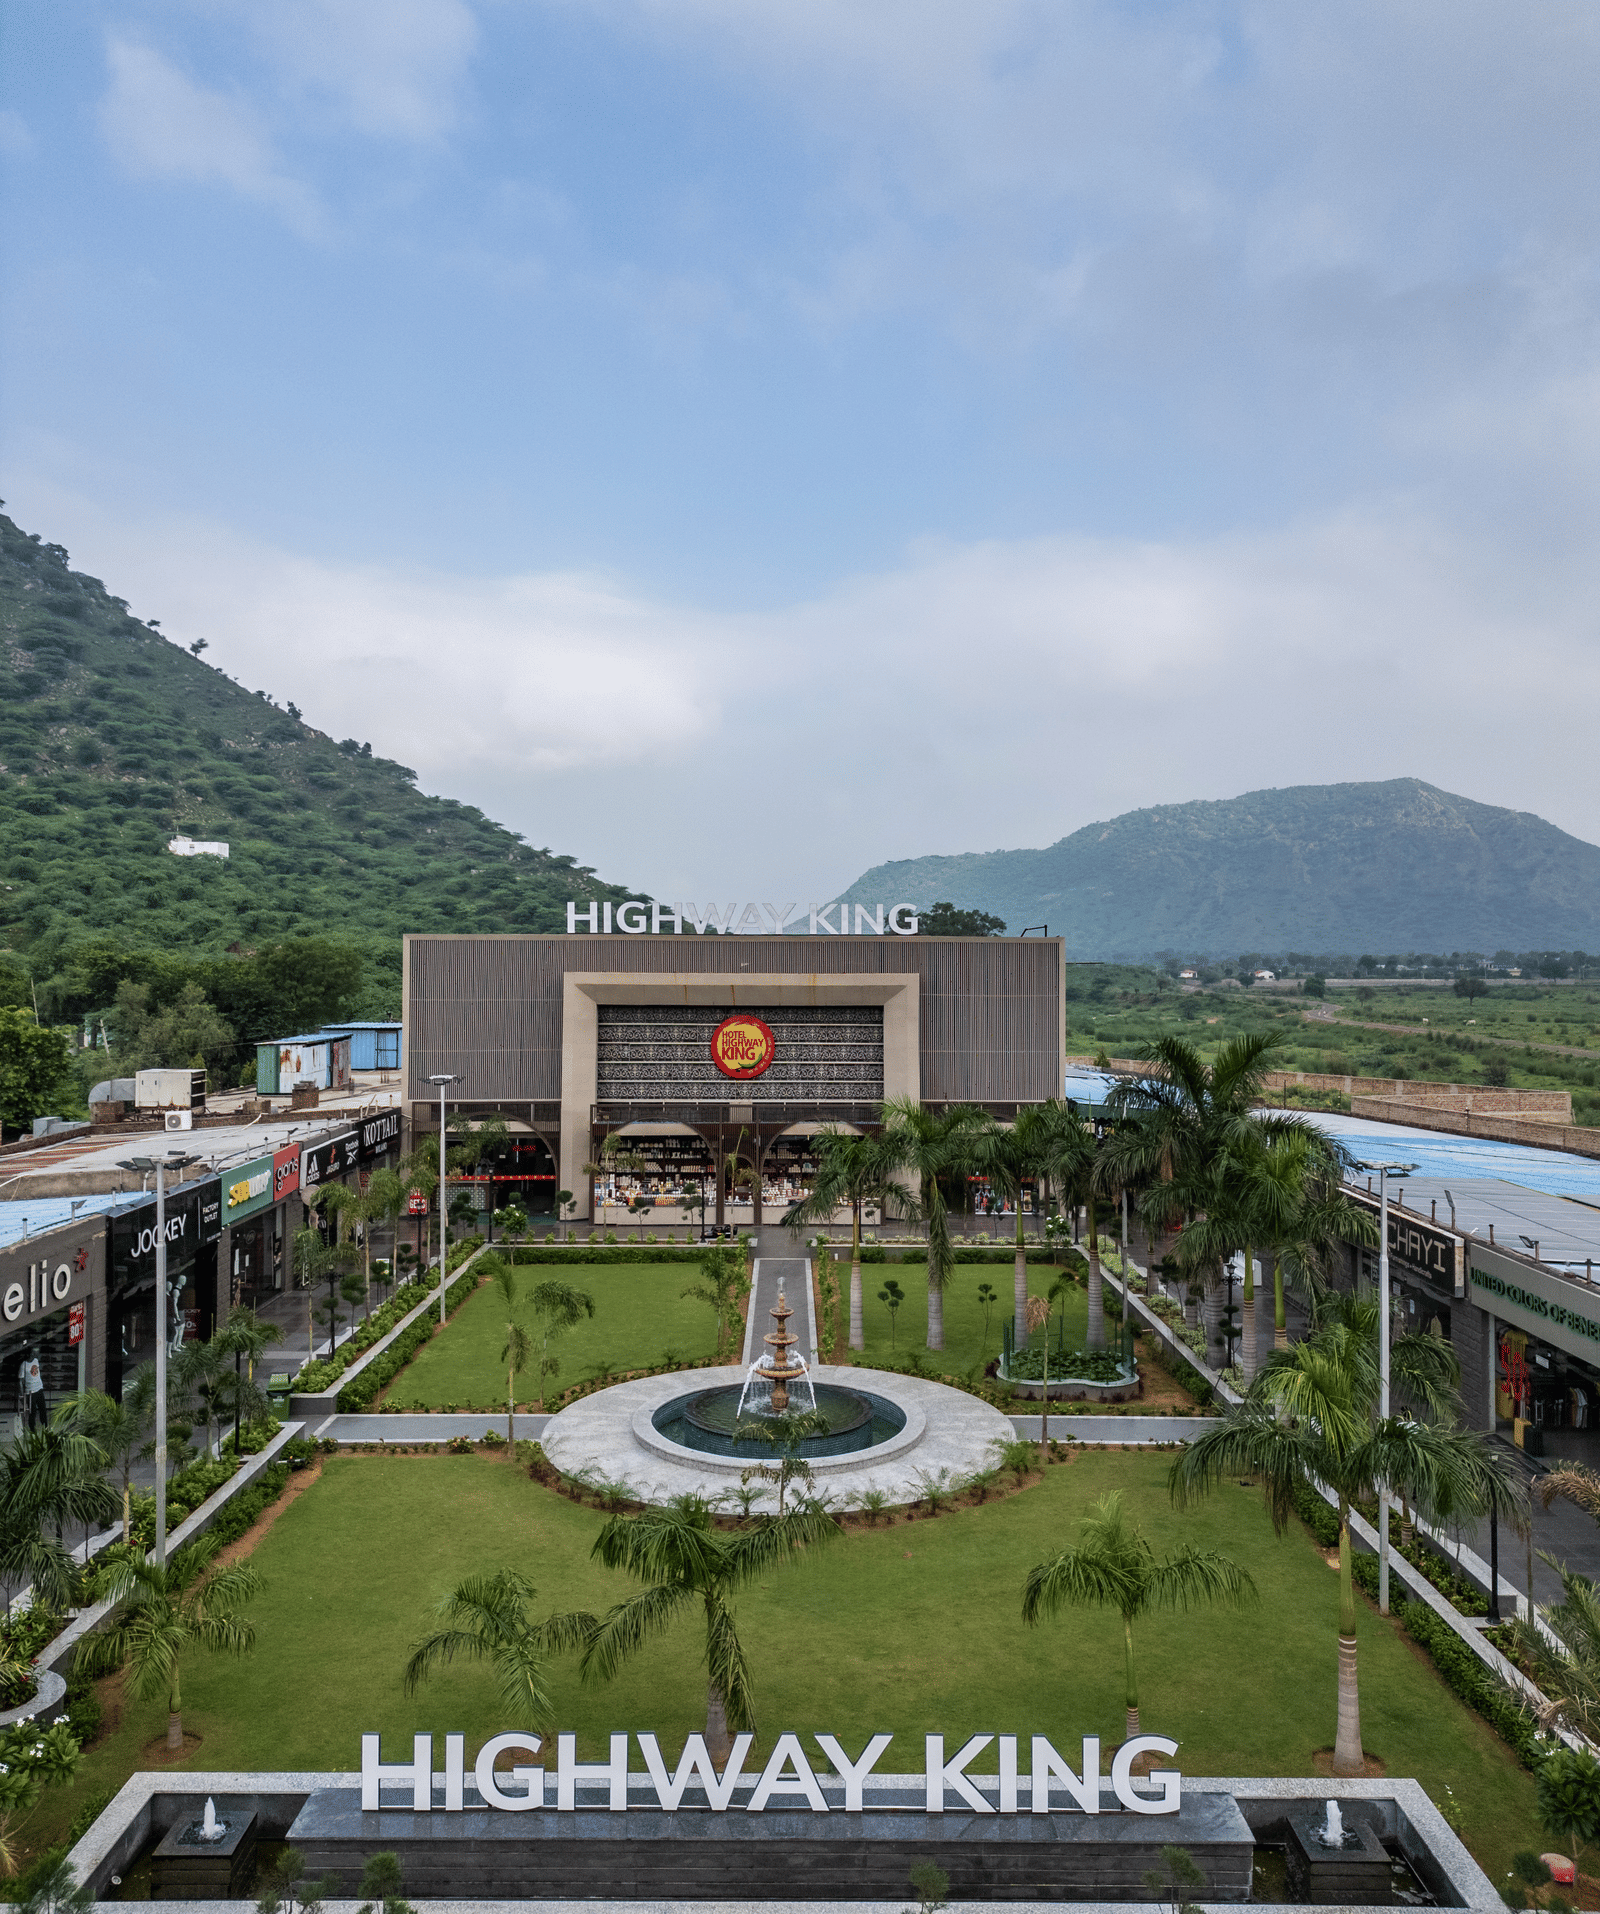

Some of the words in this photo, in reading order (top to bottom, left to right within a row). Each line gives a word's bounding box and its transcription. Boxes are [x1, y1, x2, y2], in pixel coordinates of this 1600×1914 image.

[566, 901, 797, 935] HIGHWAY
[809, 902, 919, 935] KING
[721, 1038, 764, 1047] HIGHWAY
[721, 1046, 756, 1060] KING
[131, 1213, 187, 1258] JOCKEY
[3, 1259, 72, 1322] elio
[1470, 1266, 1506, 1296] UNITED
[1506, 1283, 1549, 1317] COLORS
[1549, 1303, 1567, 1324] OF
[362, 1730, 894, 1812] HIGHWAY
[925, 1732, 1181, 1814] KING
